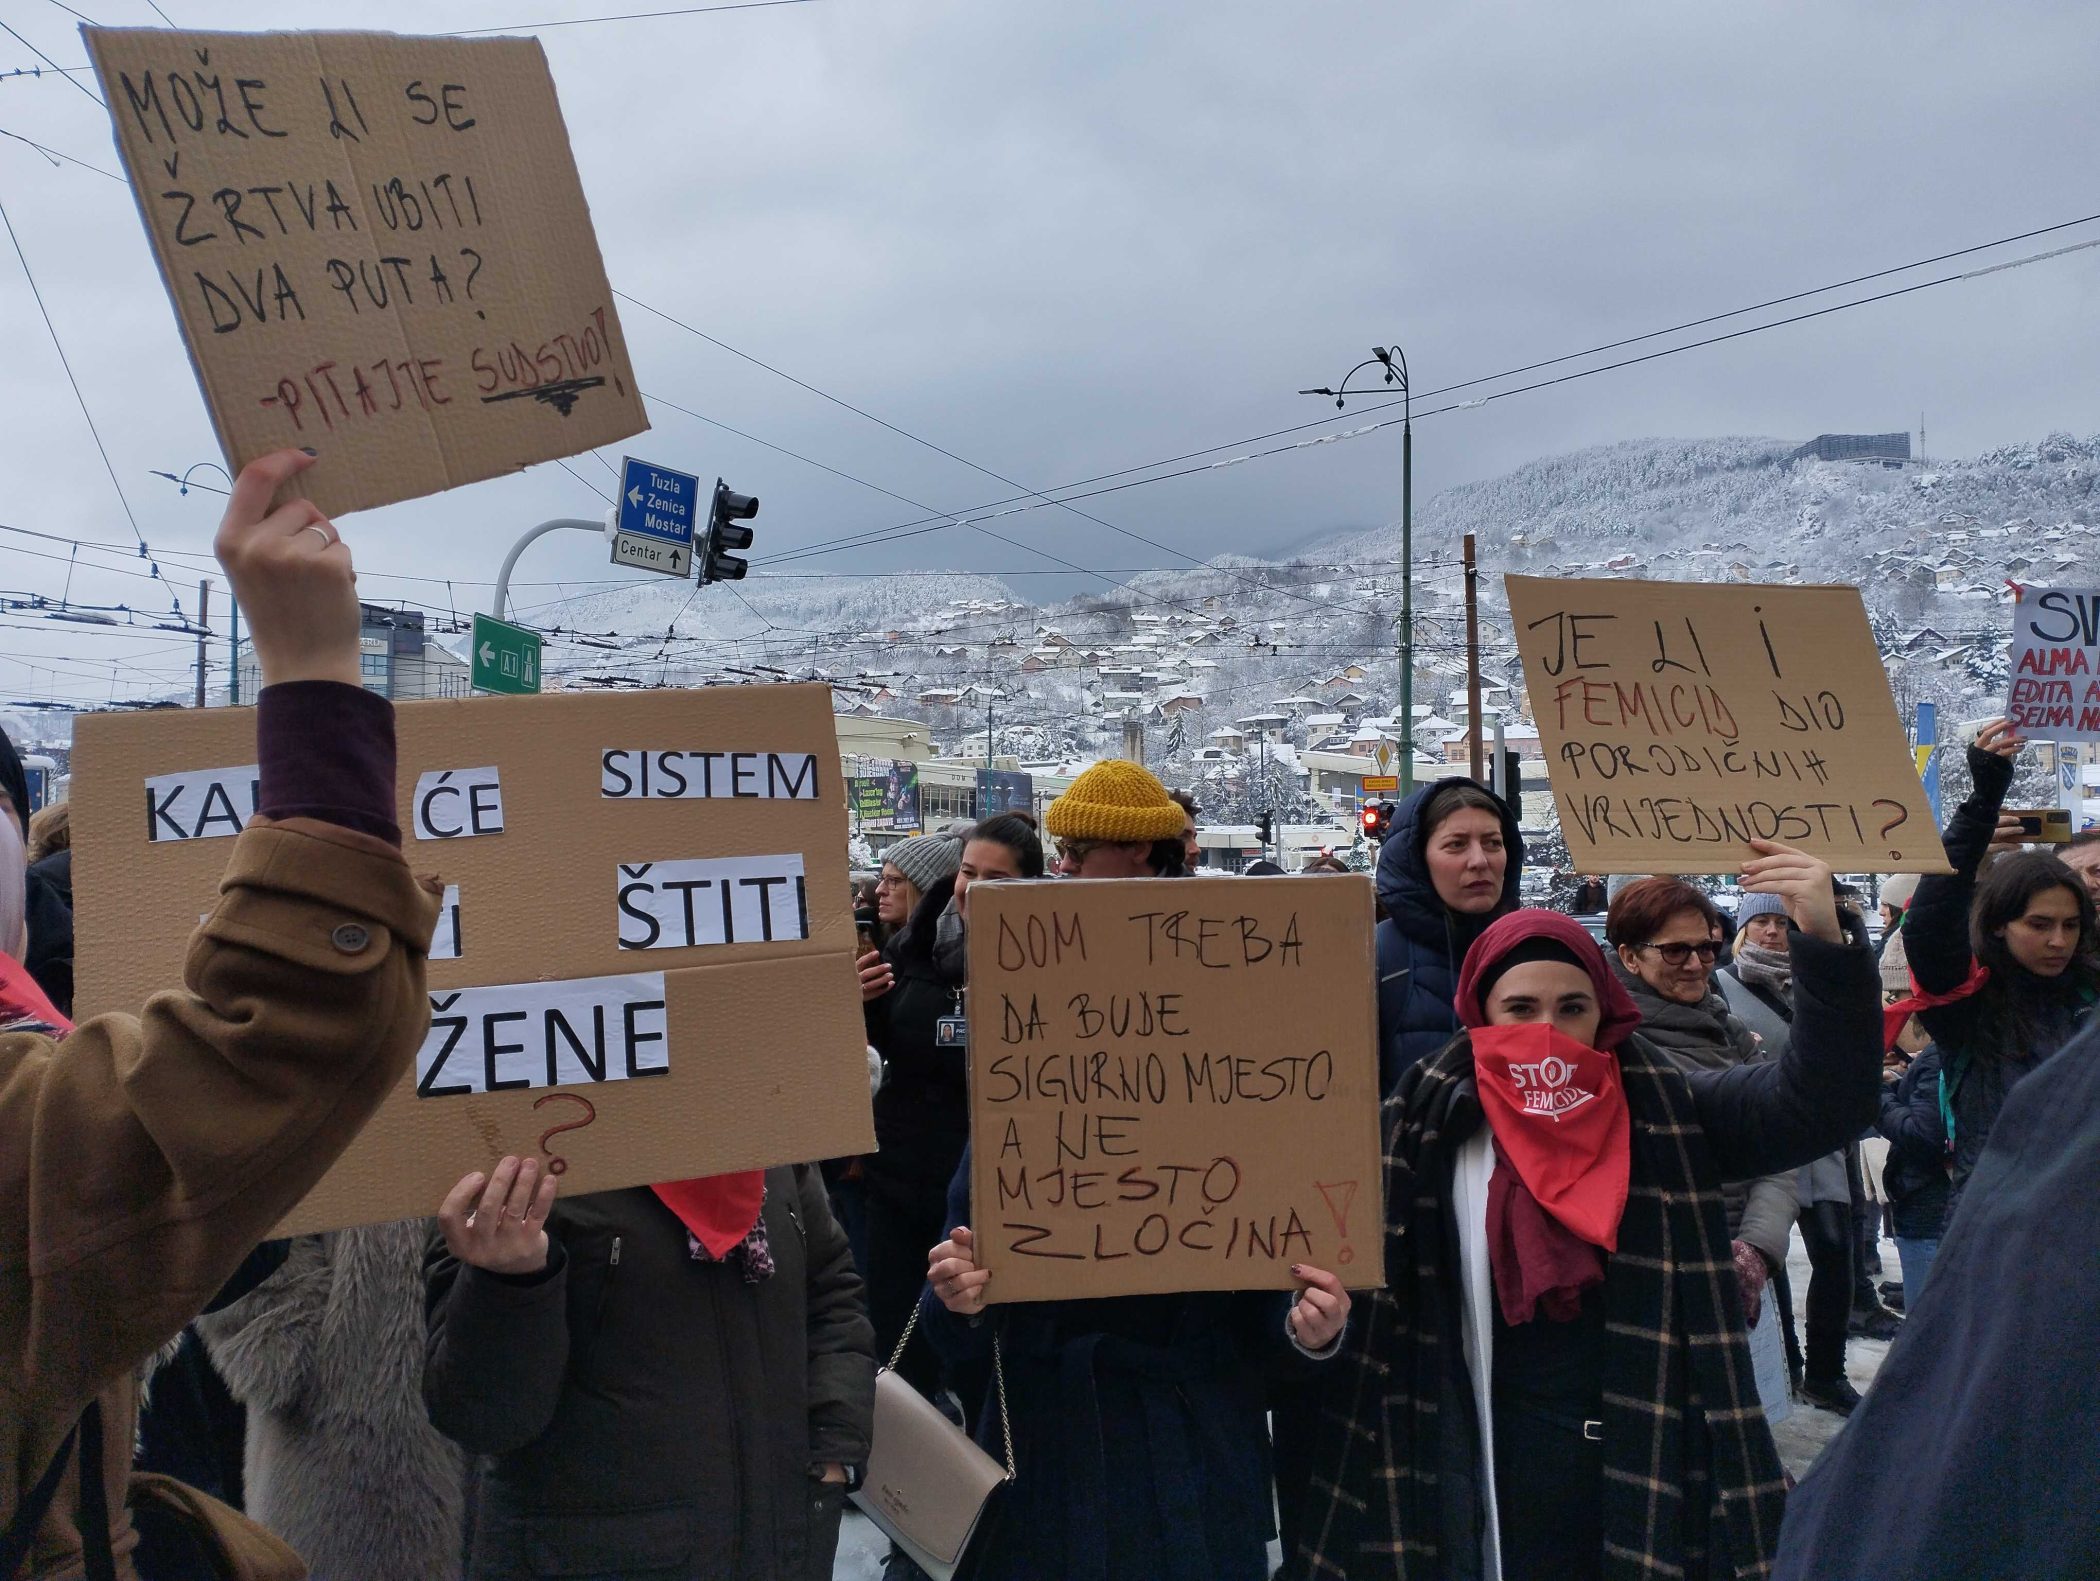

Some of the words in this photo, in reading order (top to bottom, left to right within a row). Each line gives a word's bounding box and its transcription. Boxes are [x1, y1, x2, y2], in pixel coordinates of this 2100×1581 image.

[120, 48, 287, 143] MOŽE
[320, 77, 367, 142] LI
[406, 81, 475, 131] SE
[162, 152, 359, 246] ŽRTVA
[376, 175, 482, 231] UBITI
[195, 262, 304, 333] DVA
[327, 248, 486, 320] PUTA?
[647, 493, 686, 516] Zenica
[649, 472, 681, 494] Tuzla
[620, 540, 662, 562] Centar
[644, 513, 688, 536] Mostar
[503, 653, 517, 675] A1
[1527, 611, 1619, 676] JE
[1652, 617, 1712, 677] LI
[2017, 647, 2090, 676] ALMA
[1553, 675, 1740, 739] FEMICID
[1772, 690, 1846, 732] DIO
[2010, 703, 2074, 728] SELMA
[2011, 678, 2074, 704] EDITA
[1560, 740, 1828, 787] PORODIČNIH
[146, 780, 260, 841] KA
[420, 771, 503, 838] ĆE
[601, 750, 819, 800] SISTEM
[618, 863, 809, 952] ŠTITI
[998, 911, 1087, 972] DOM
[1128, 910, 1303, 968] TREBA
[417, 991, 669, 1097] ŽENE
[1000, 992, 1048, 1044] DA
[1068, 991, 1190, 1039] BUDE
[987, 1051, 1166, 1104] SIGURNO
[1183, 1050, 1333, 1104] MJESTO
[532, 1093, 597, 1175] ?
[1000, 1117, 1023, 1160] A
[1055, 1110, 1141, 1166] NE
[997, 1156, 1242, 1211] MJESTO
